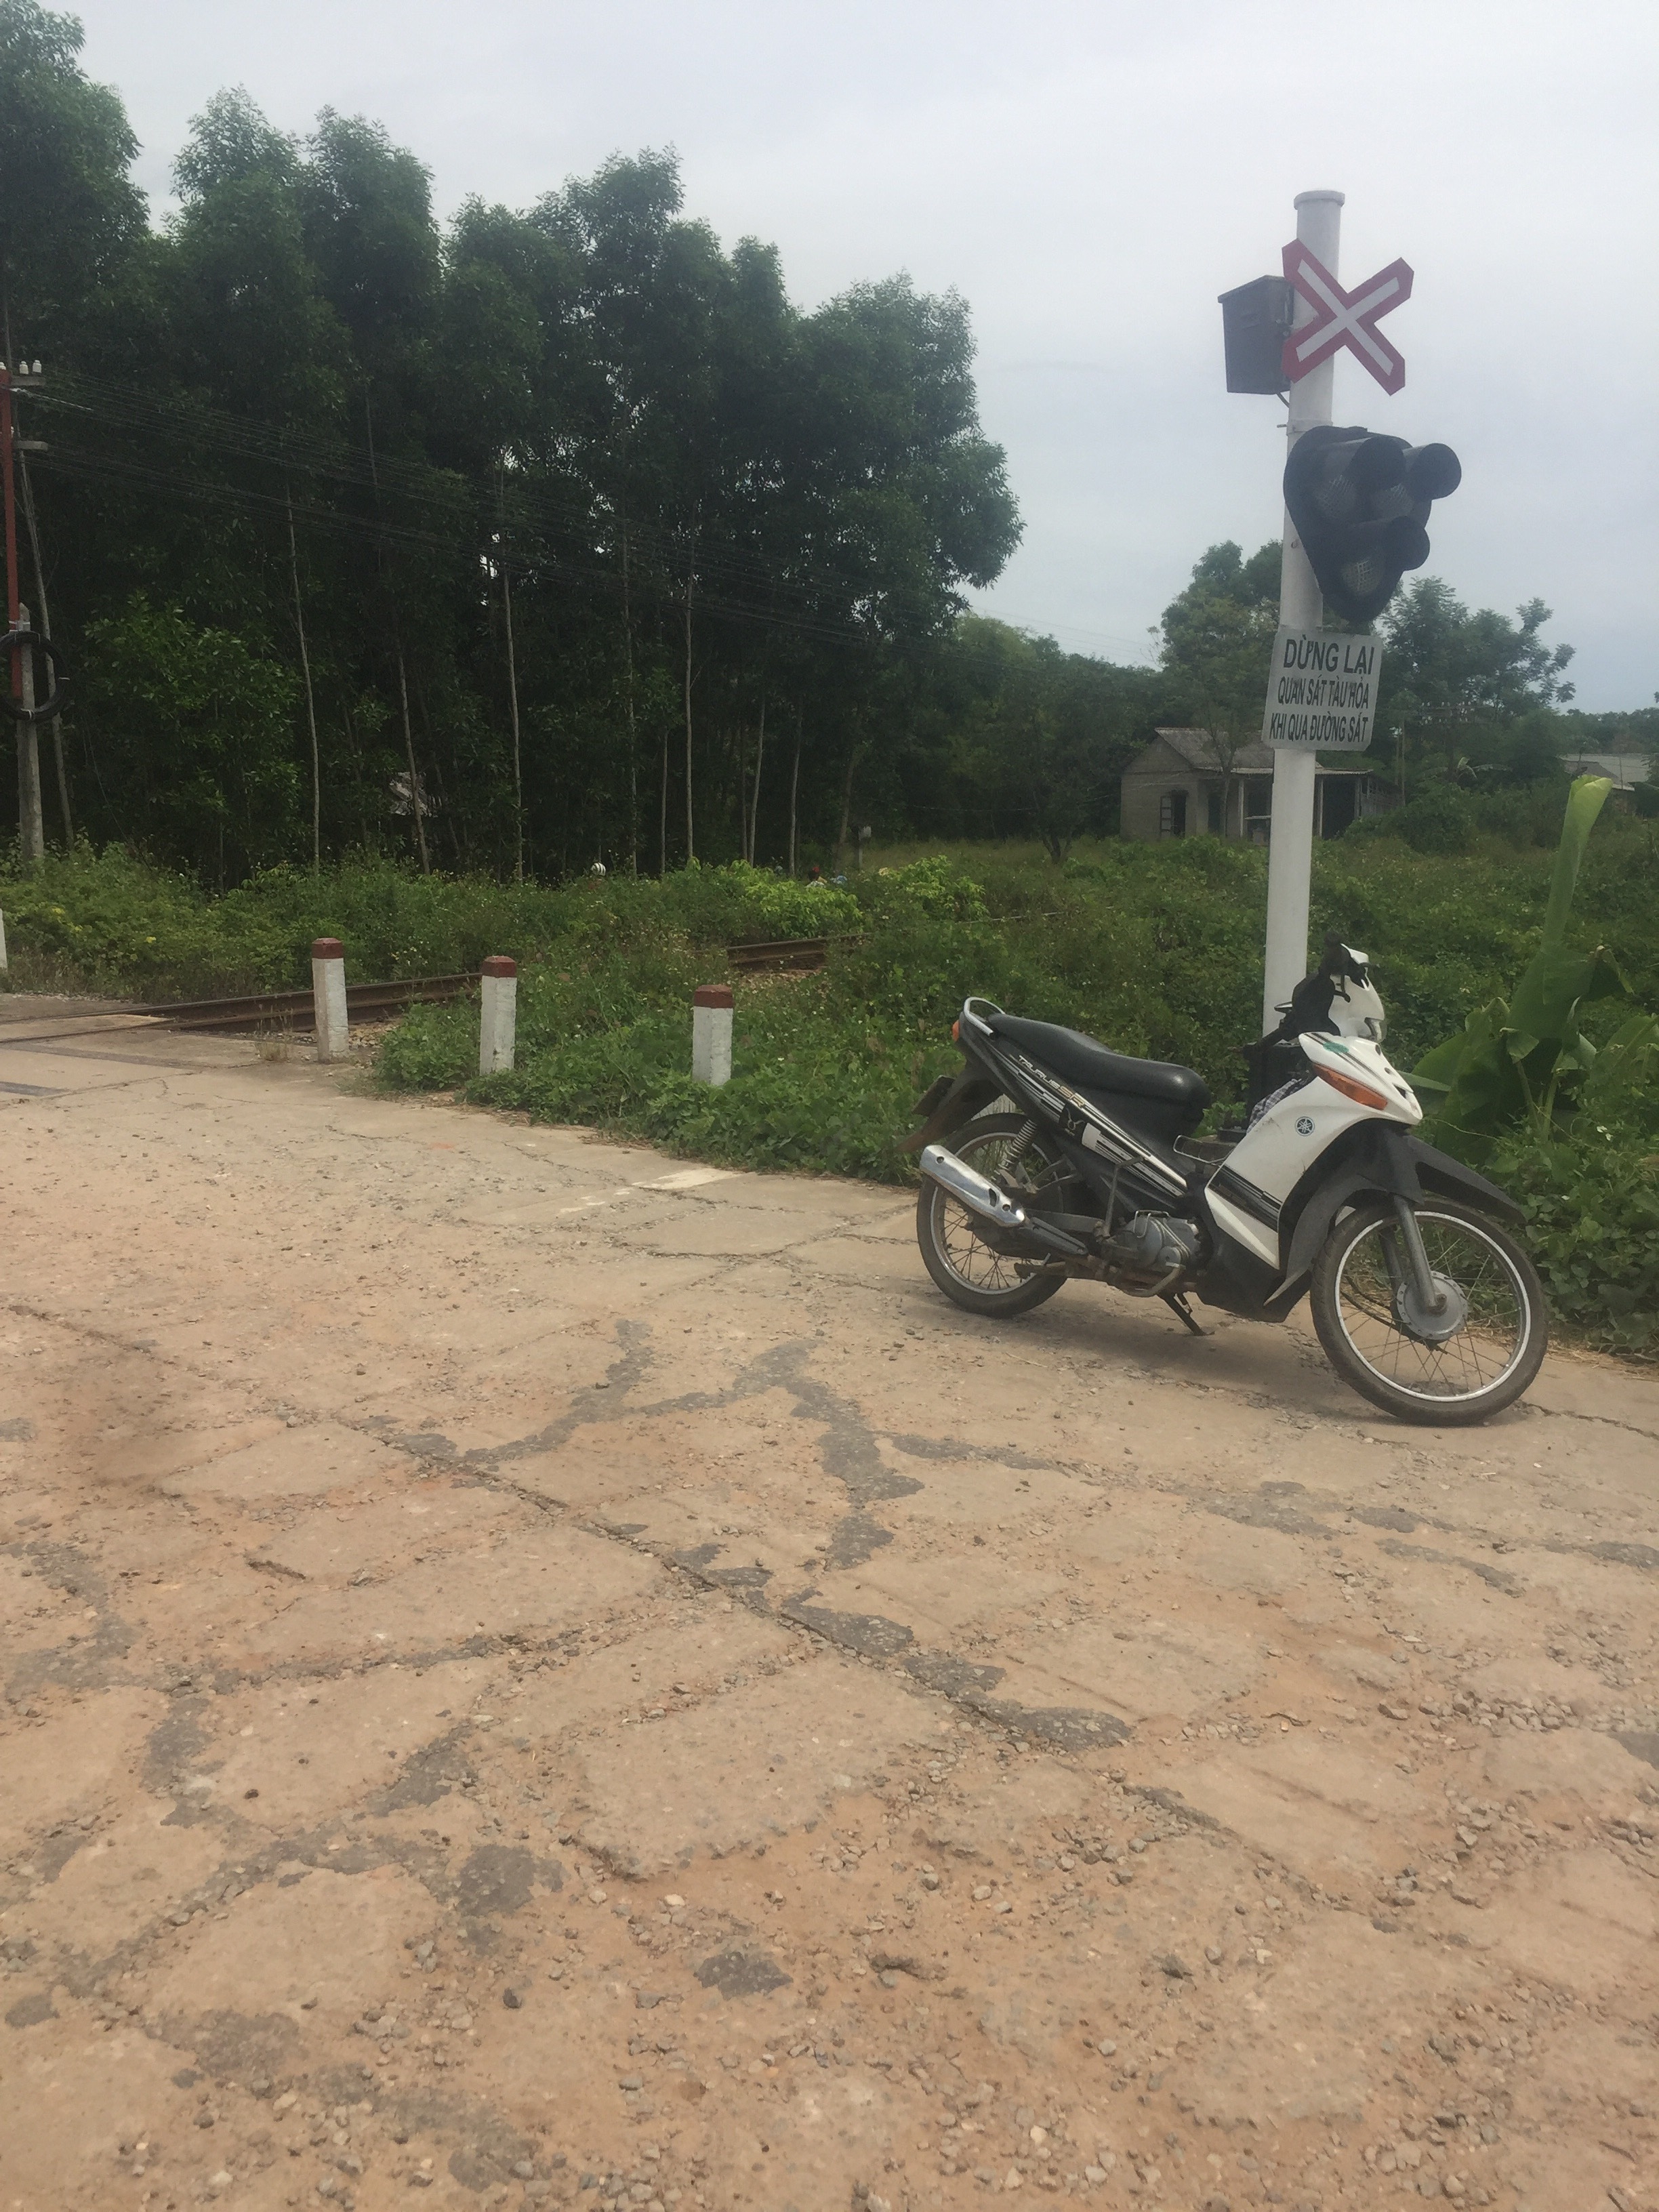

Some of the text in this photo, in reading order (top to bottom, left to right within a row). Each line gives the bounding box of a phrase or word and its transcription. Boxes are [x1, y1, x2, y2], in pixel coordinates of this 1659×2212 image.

[1284, 634, 1375, 674] DỪNG LẠI
[1277, 674, 1369, 709] QUAN SÁT TÀU HỎA
[1269, 713, 1287, 739] KHI
[1288, 714, 1308, 741] QUA
[1309, 711, 1347, 742] ĐƯỜNG
